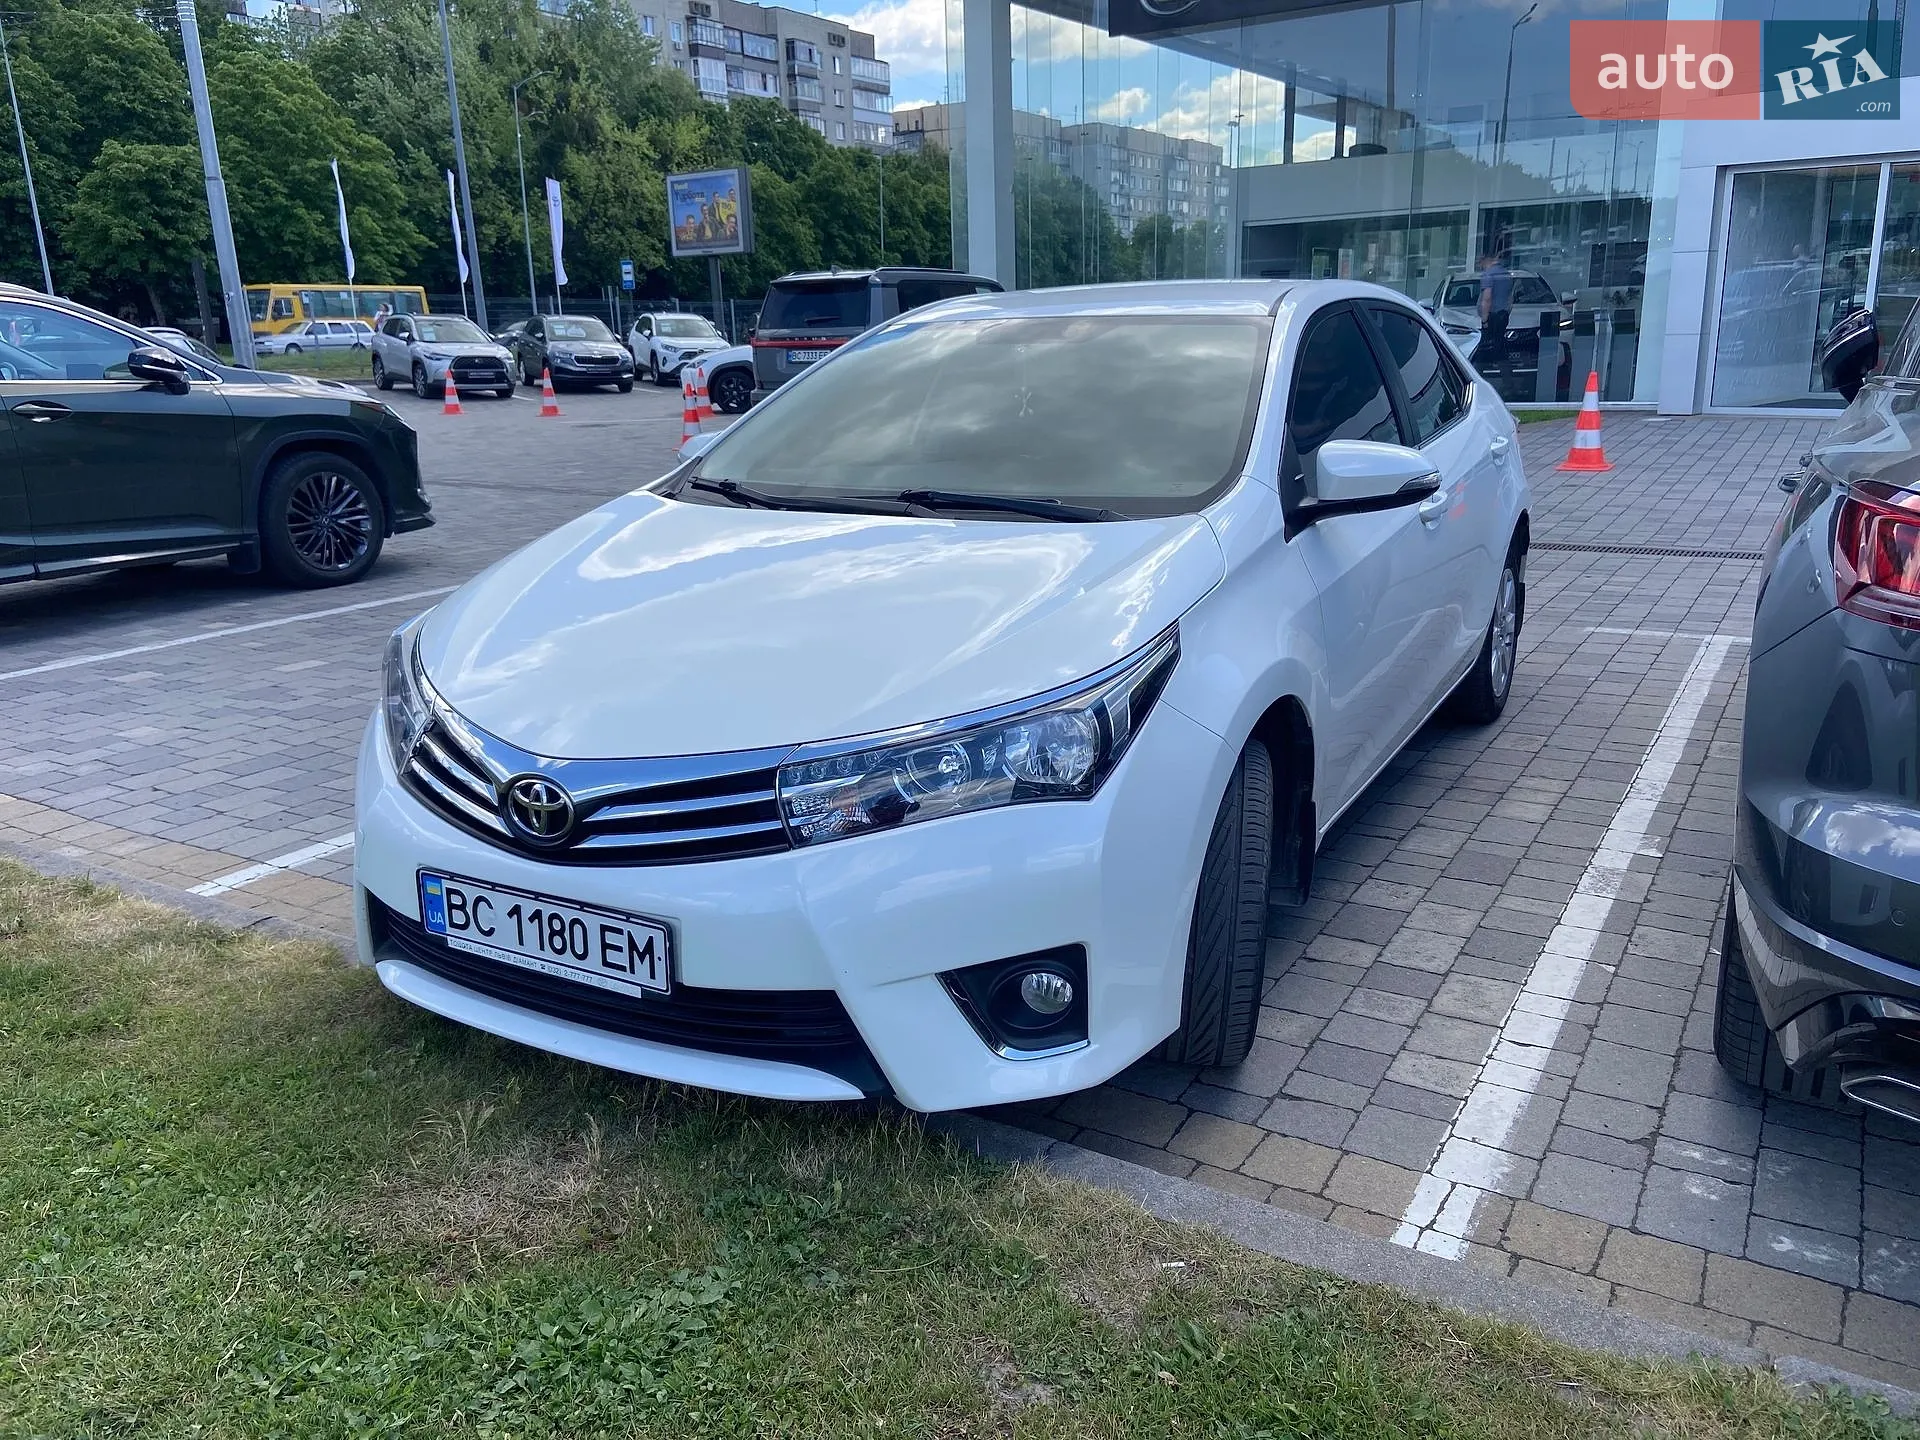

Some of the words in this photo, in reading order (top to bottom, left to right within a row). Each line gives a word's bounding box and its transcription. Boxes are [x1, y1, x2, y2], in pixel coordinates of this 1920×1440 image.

[792, 351, 802, 361] BC
[803, 351, 818, 361] 7333
[428, 909, 445, 926] UA
[445, 886, 496, 938] BC
[506, 903, 590, 961] 1180
[599, 923, 656, 981] EM
